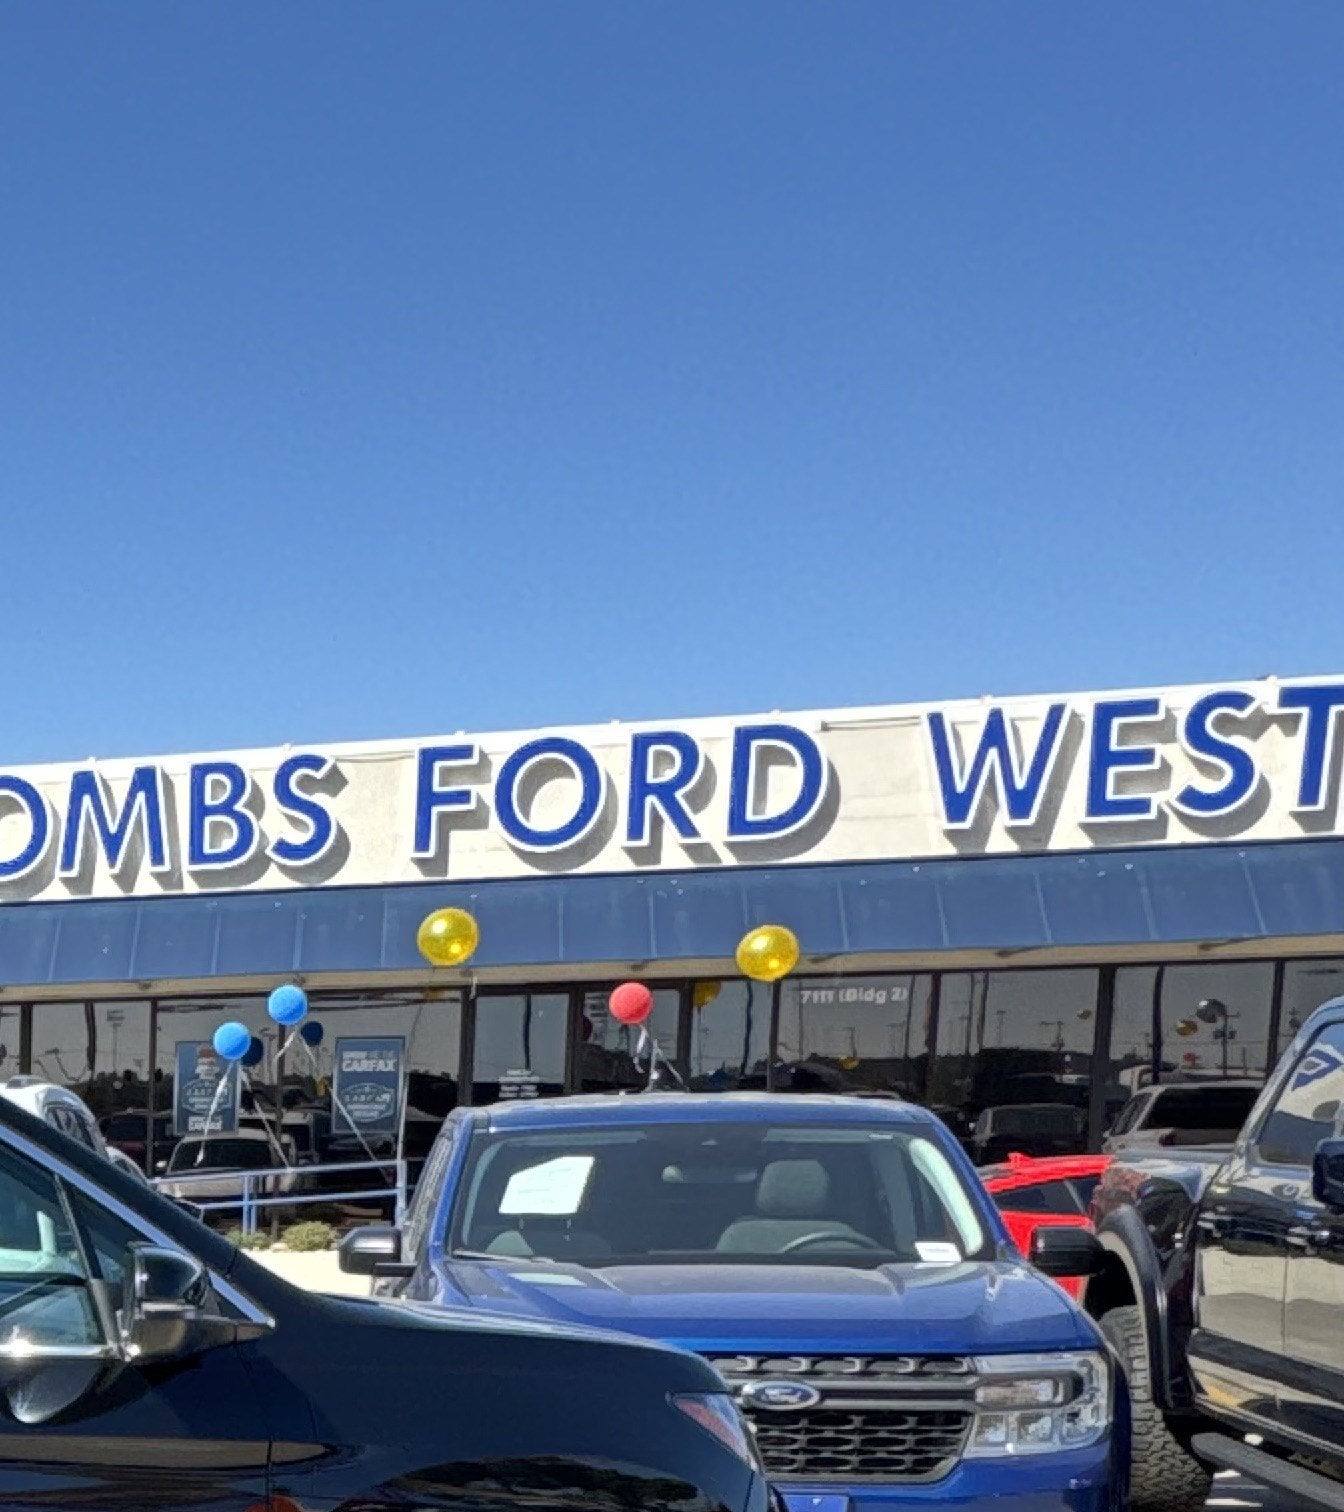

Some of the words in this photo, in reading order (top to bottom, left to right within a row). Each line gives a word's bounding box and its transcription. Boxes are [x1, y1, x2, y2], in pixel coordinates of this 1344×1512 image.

[412, 722, 828, 858] FORD
[924, 684, 1344, 829] WEST
[342, 1058, 397, 1073] CARFAX
